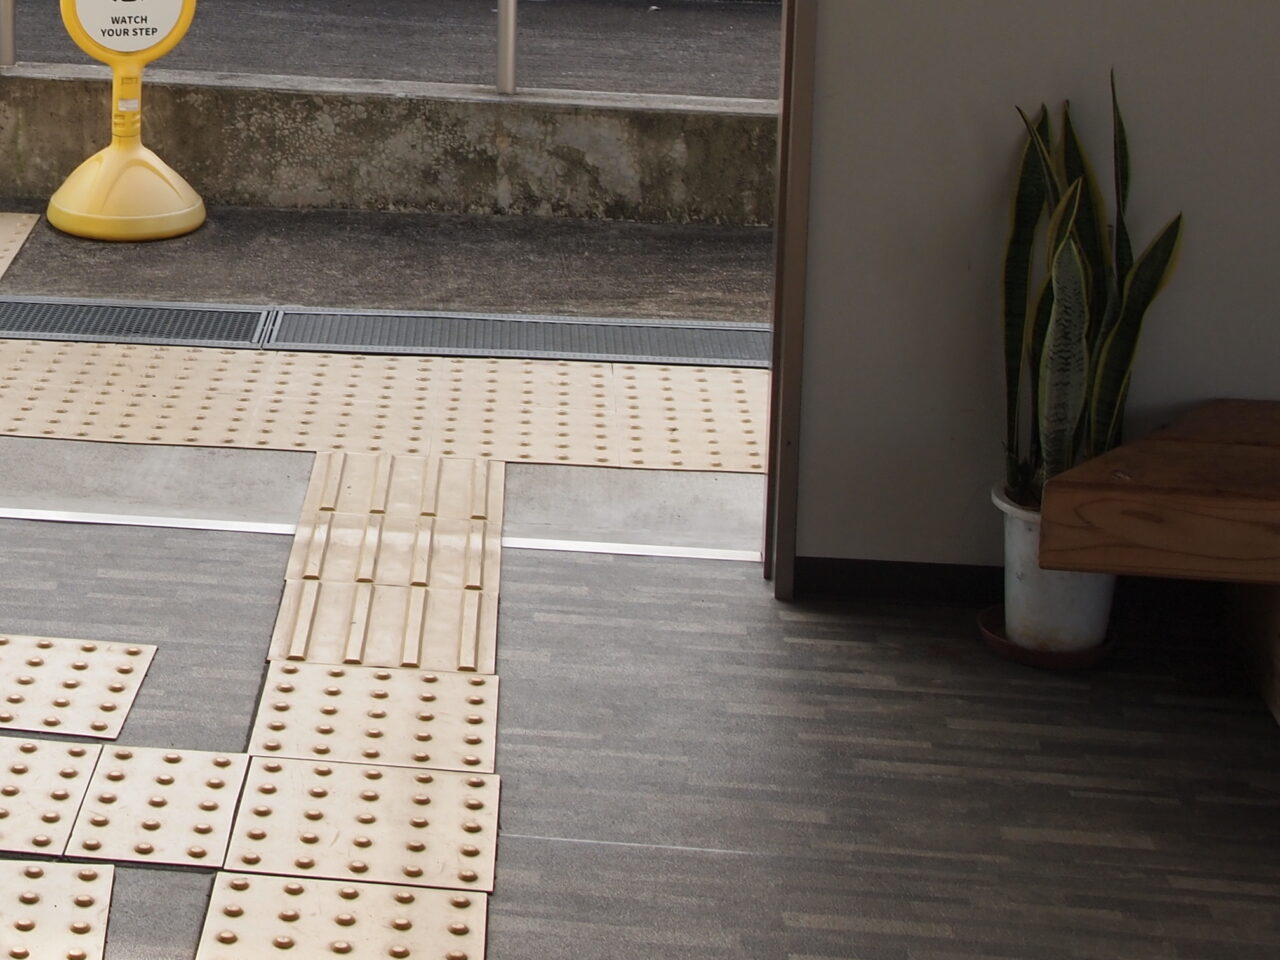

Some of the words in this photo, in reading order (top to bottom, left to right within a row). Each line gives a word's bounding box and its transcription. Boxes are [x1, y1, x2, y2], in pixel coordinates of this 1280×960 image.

[111, 16, 148, 25] WATCH
[101, 27, 129, 37] YOUR
[132, 27, 158, 36] STEP
